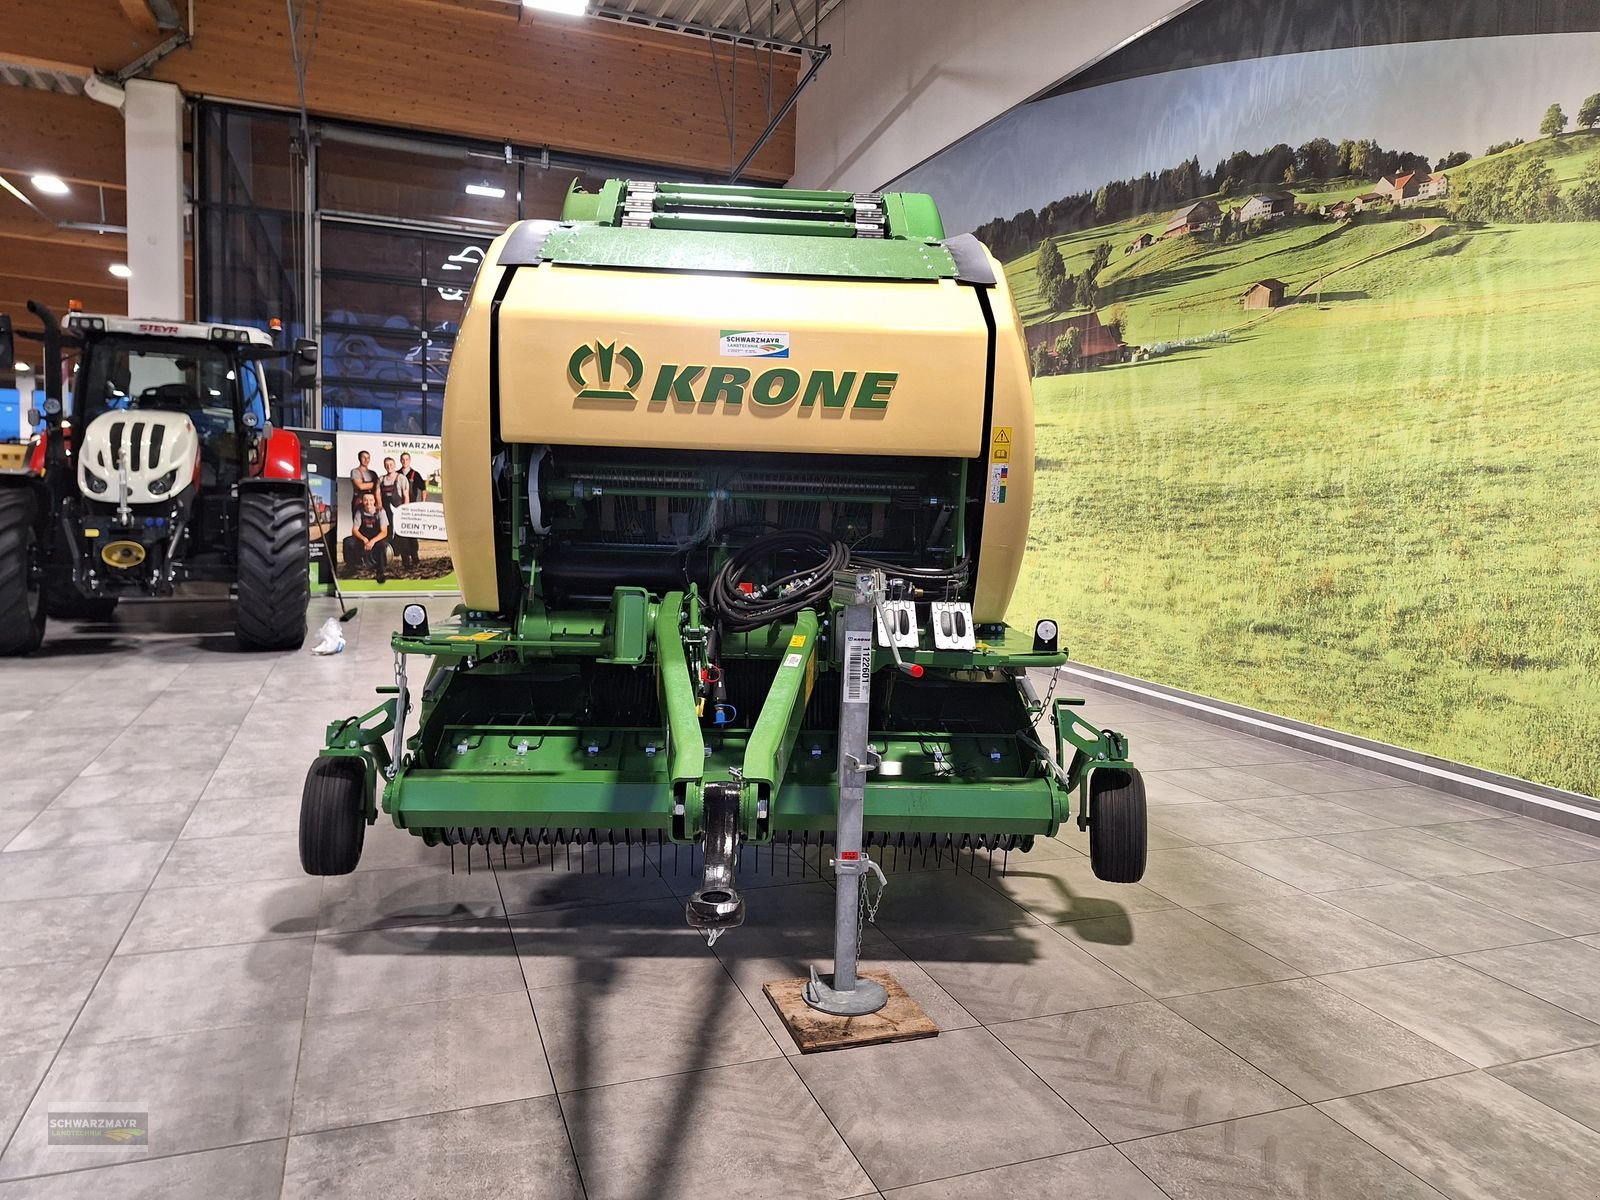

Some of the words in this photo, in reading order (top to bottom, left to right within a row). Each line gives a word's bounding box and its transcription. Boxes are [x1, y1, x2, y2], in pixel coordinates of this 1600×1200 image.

[139, 324, 179, 334] STEYR
[726, 336, 780, 344] SCHWARZMAYR
[650, 363, 899, 410] KRONE
[382, 440, 442, 450] SCHWARZMA
[861, 647, 871, 684] 1122601
